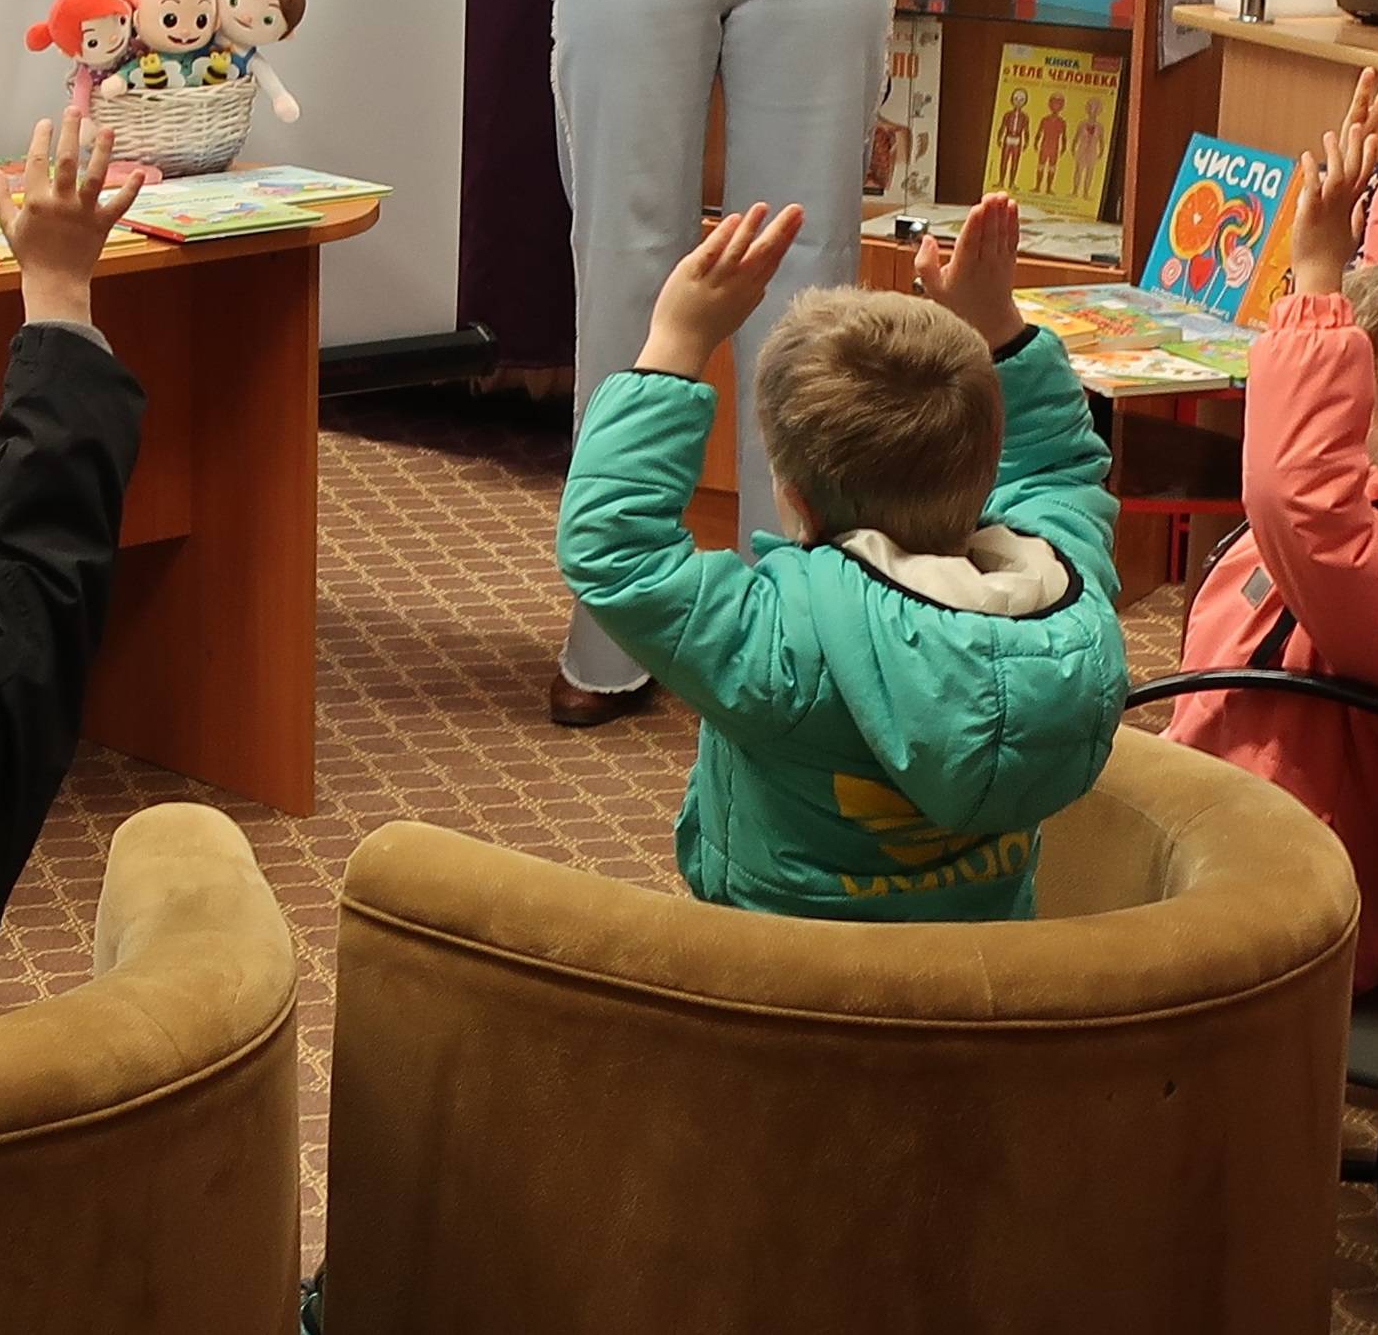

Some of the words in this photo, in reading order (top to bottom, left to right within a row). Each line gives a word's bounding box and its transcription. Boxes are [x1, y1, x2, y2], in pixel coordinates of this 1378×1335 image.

[1045, 56, 1080, 69] КНИГА
[1012, 64, 1043, 80] ТЕЛЕ
[1048, 68, 1118, 88] ЧЕЛОВЕКА
